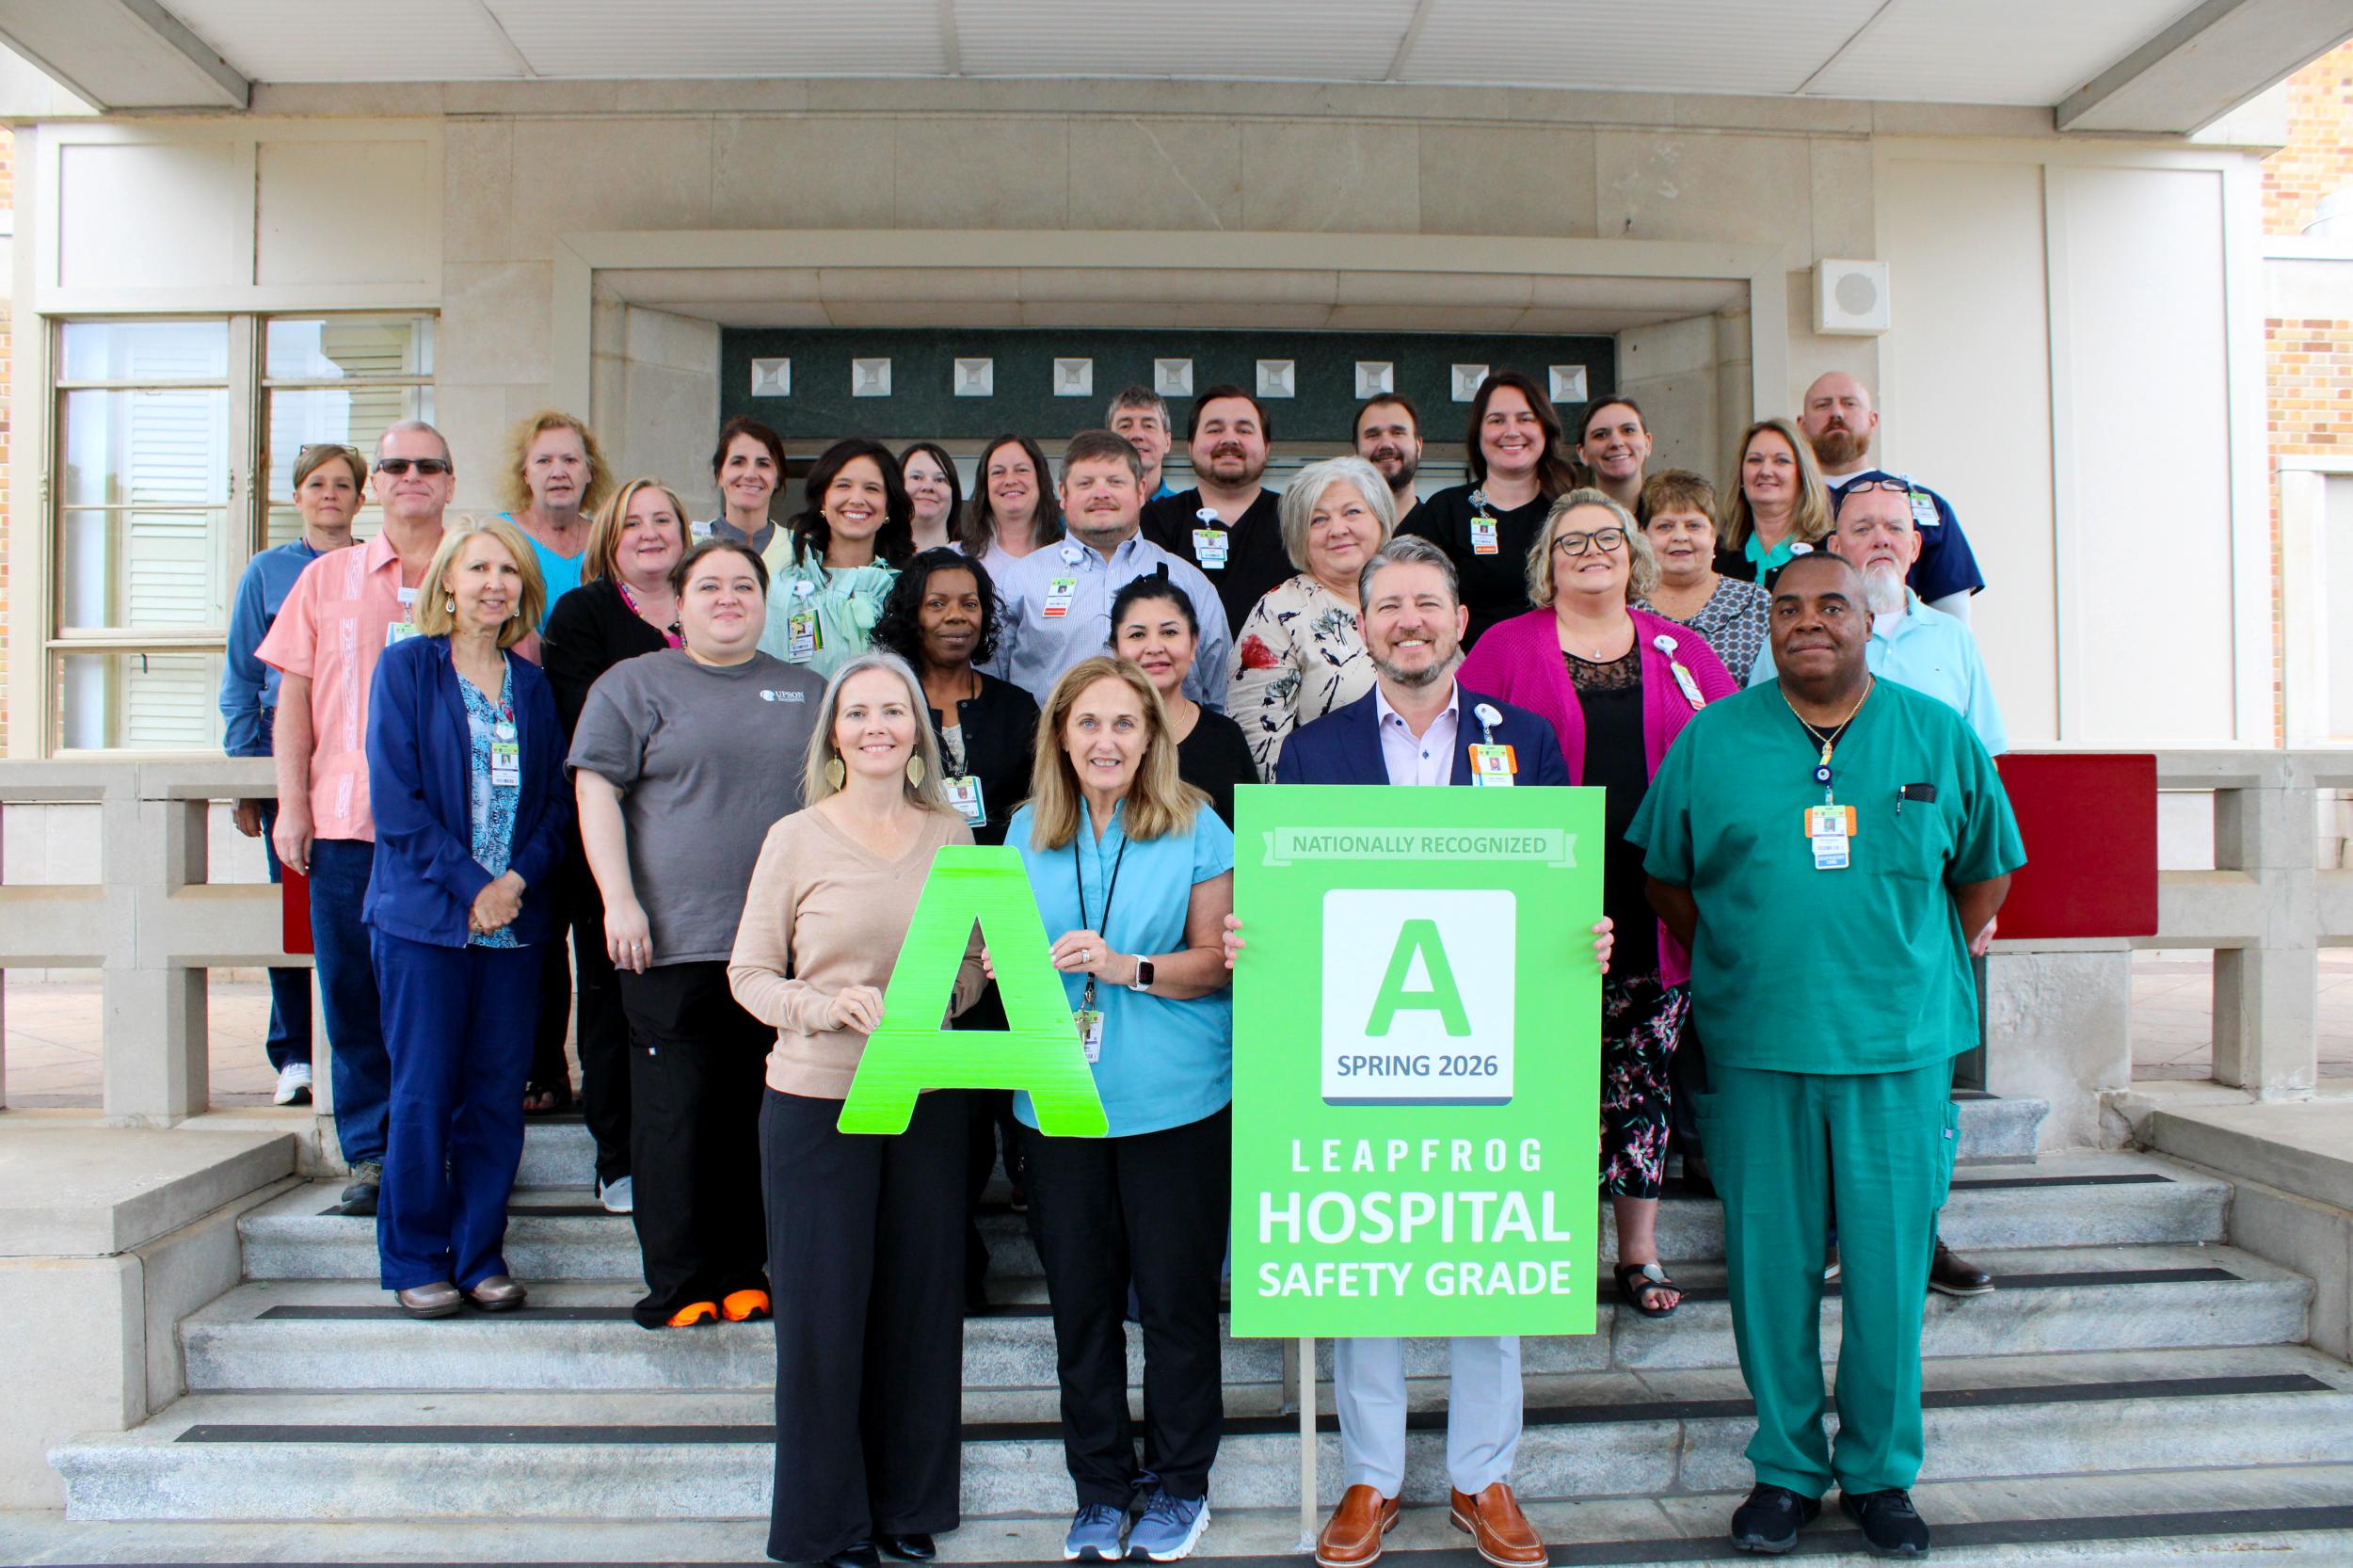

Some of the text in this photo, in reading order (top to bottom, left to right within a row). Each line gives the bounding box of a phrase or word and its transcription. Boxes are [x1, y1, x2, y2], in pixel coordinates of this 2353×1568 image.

[1293, 836, 1546, 854] NATIONALLY RECOGNIZED
[837, 844, 1109, 1137] A
[1365, 919, 1472, 1037] A
[1337, 1054, 1498, 1078] SPRING 2026
[1291, 1138, 1541, 1173] LEAPFROG
[1258, 1190, 1571, 1244] HOSPITAL
[1257, 1260, 1571, 1297] SAFETY GRADE
